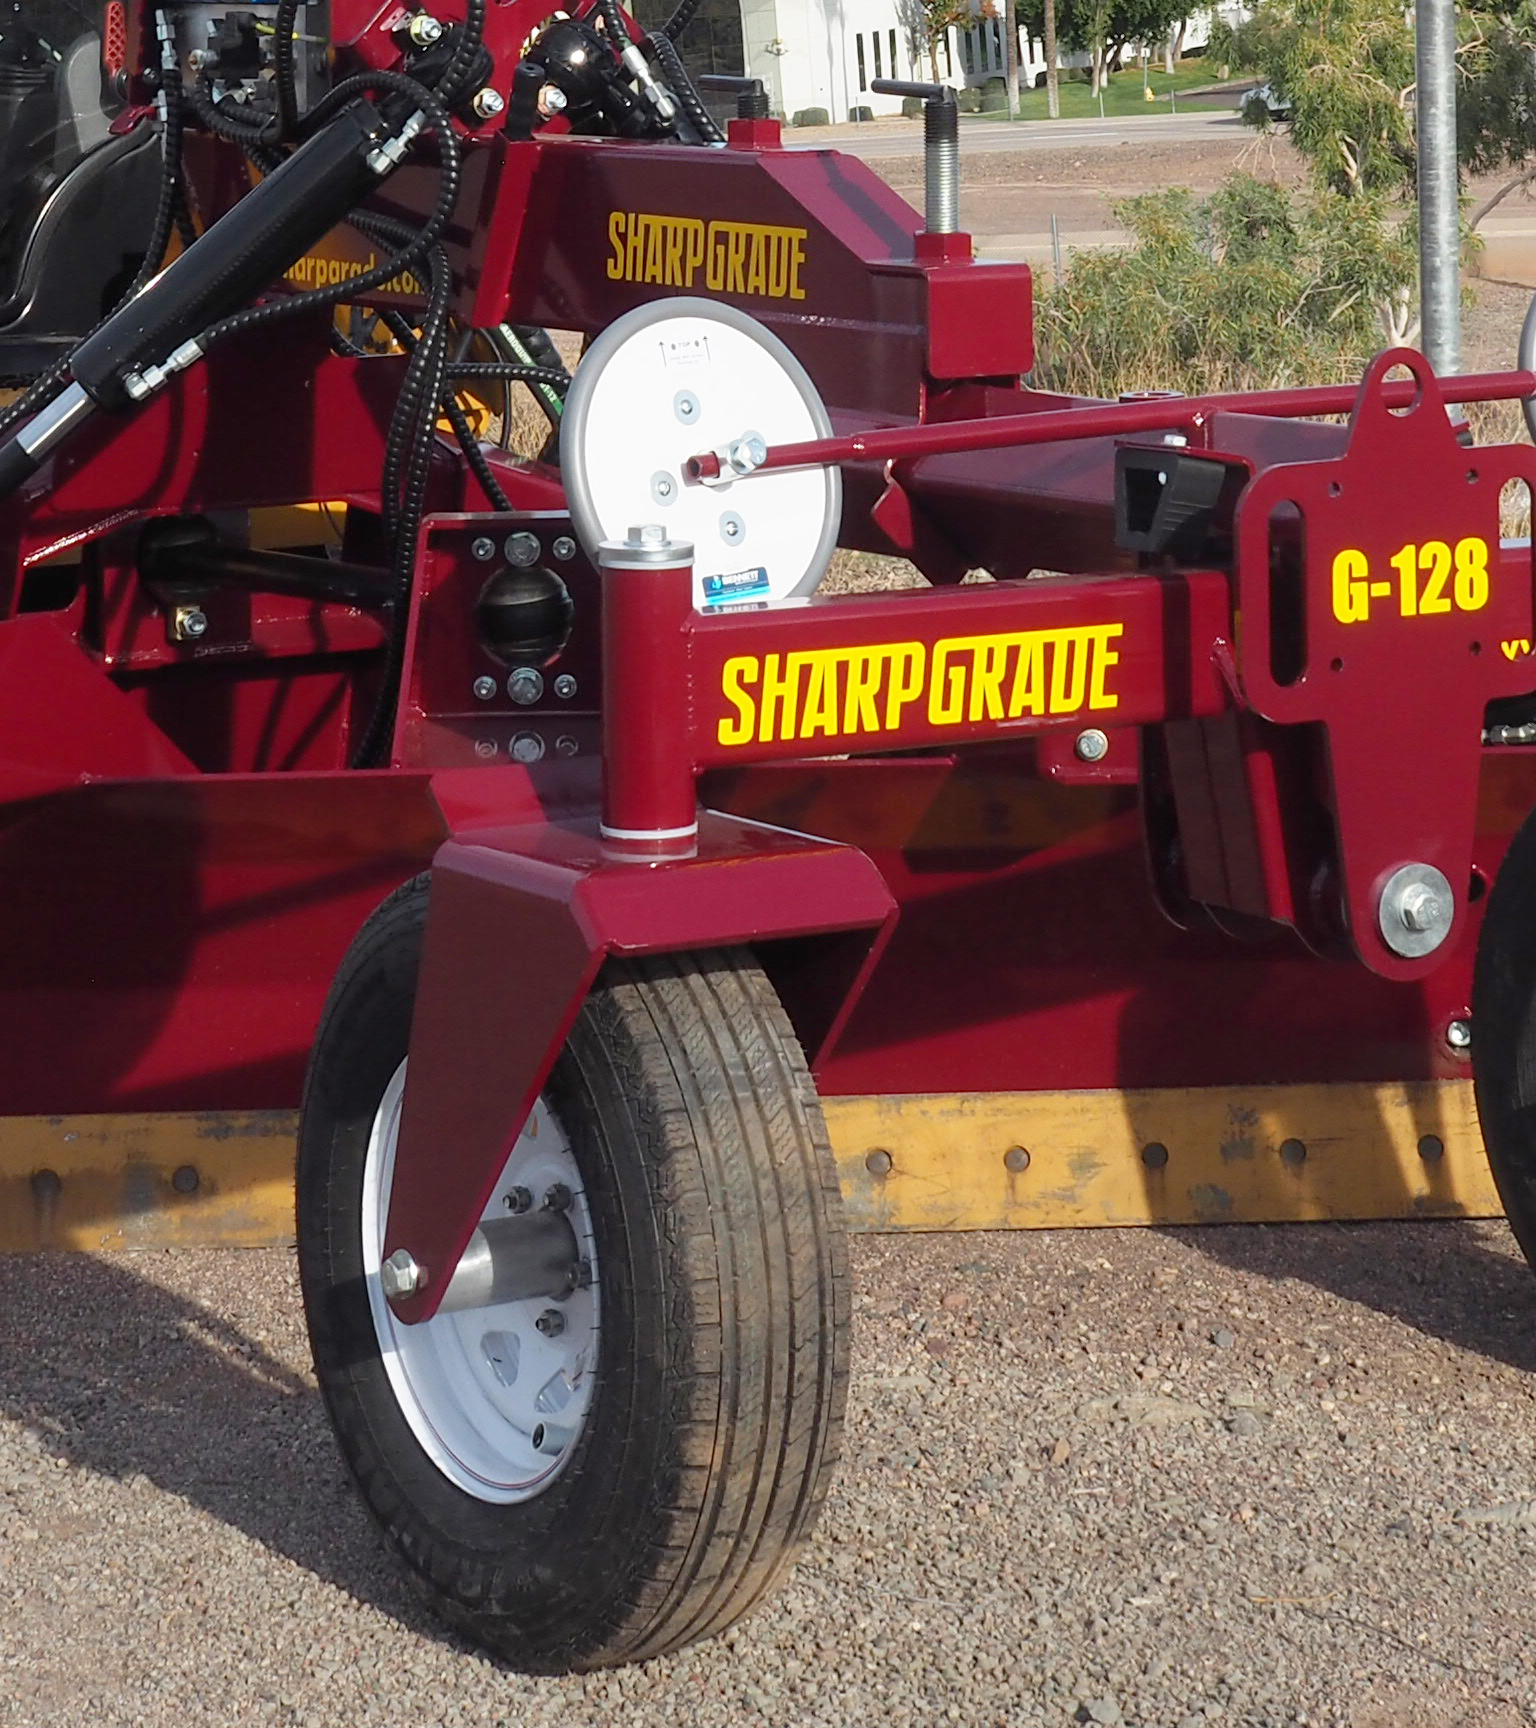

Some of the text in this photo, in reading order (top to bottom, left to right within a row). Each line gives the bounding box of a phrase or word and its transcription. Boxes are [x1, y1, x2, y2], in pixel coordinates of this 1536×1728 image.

[607, 211, 808, 300] SHARPGRADE
[1332, 537, 1489, 624] G-128
[717, 623, 1124, 746] SHARPGRADE
